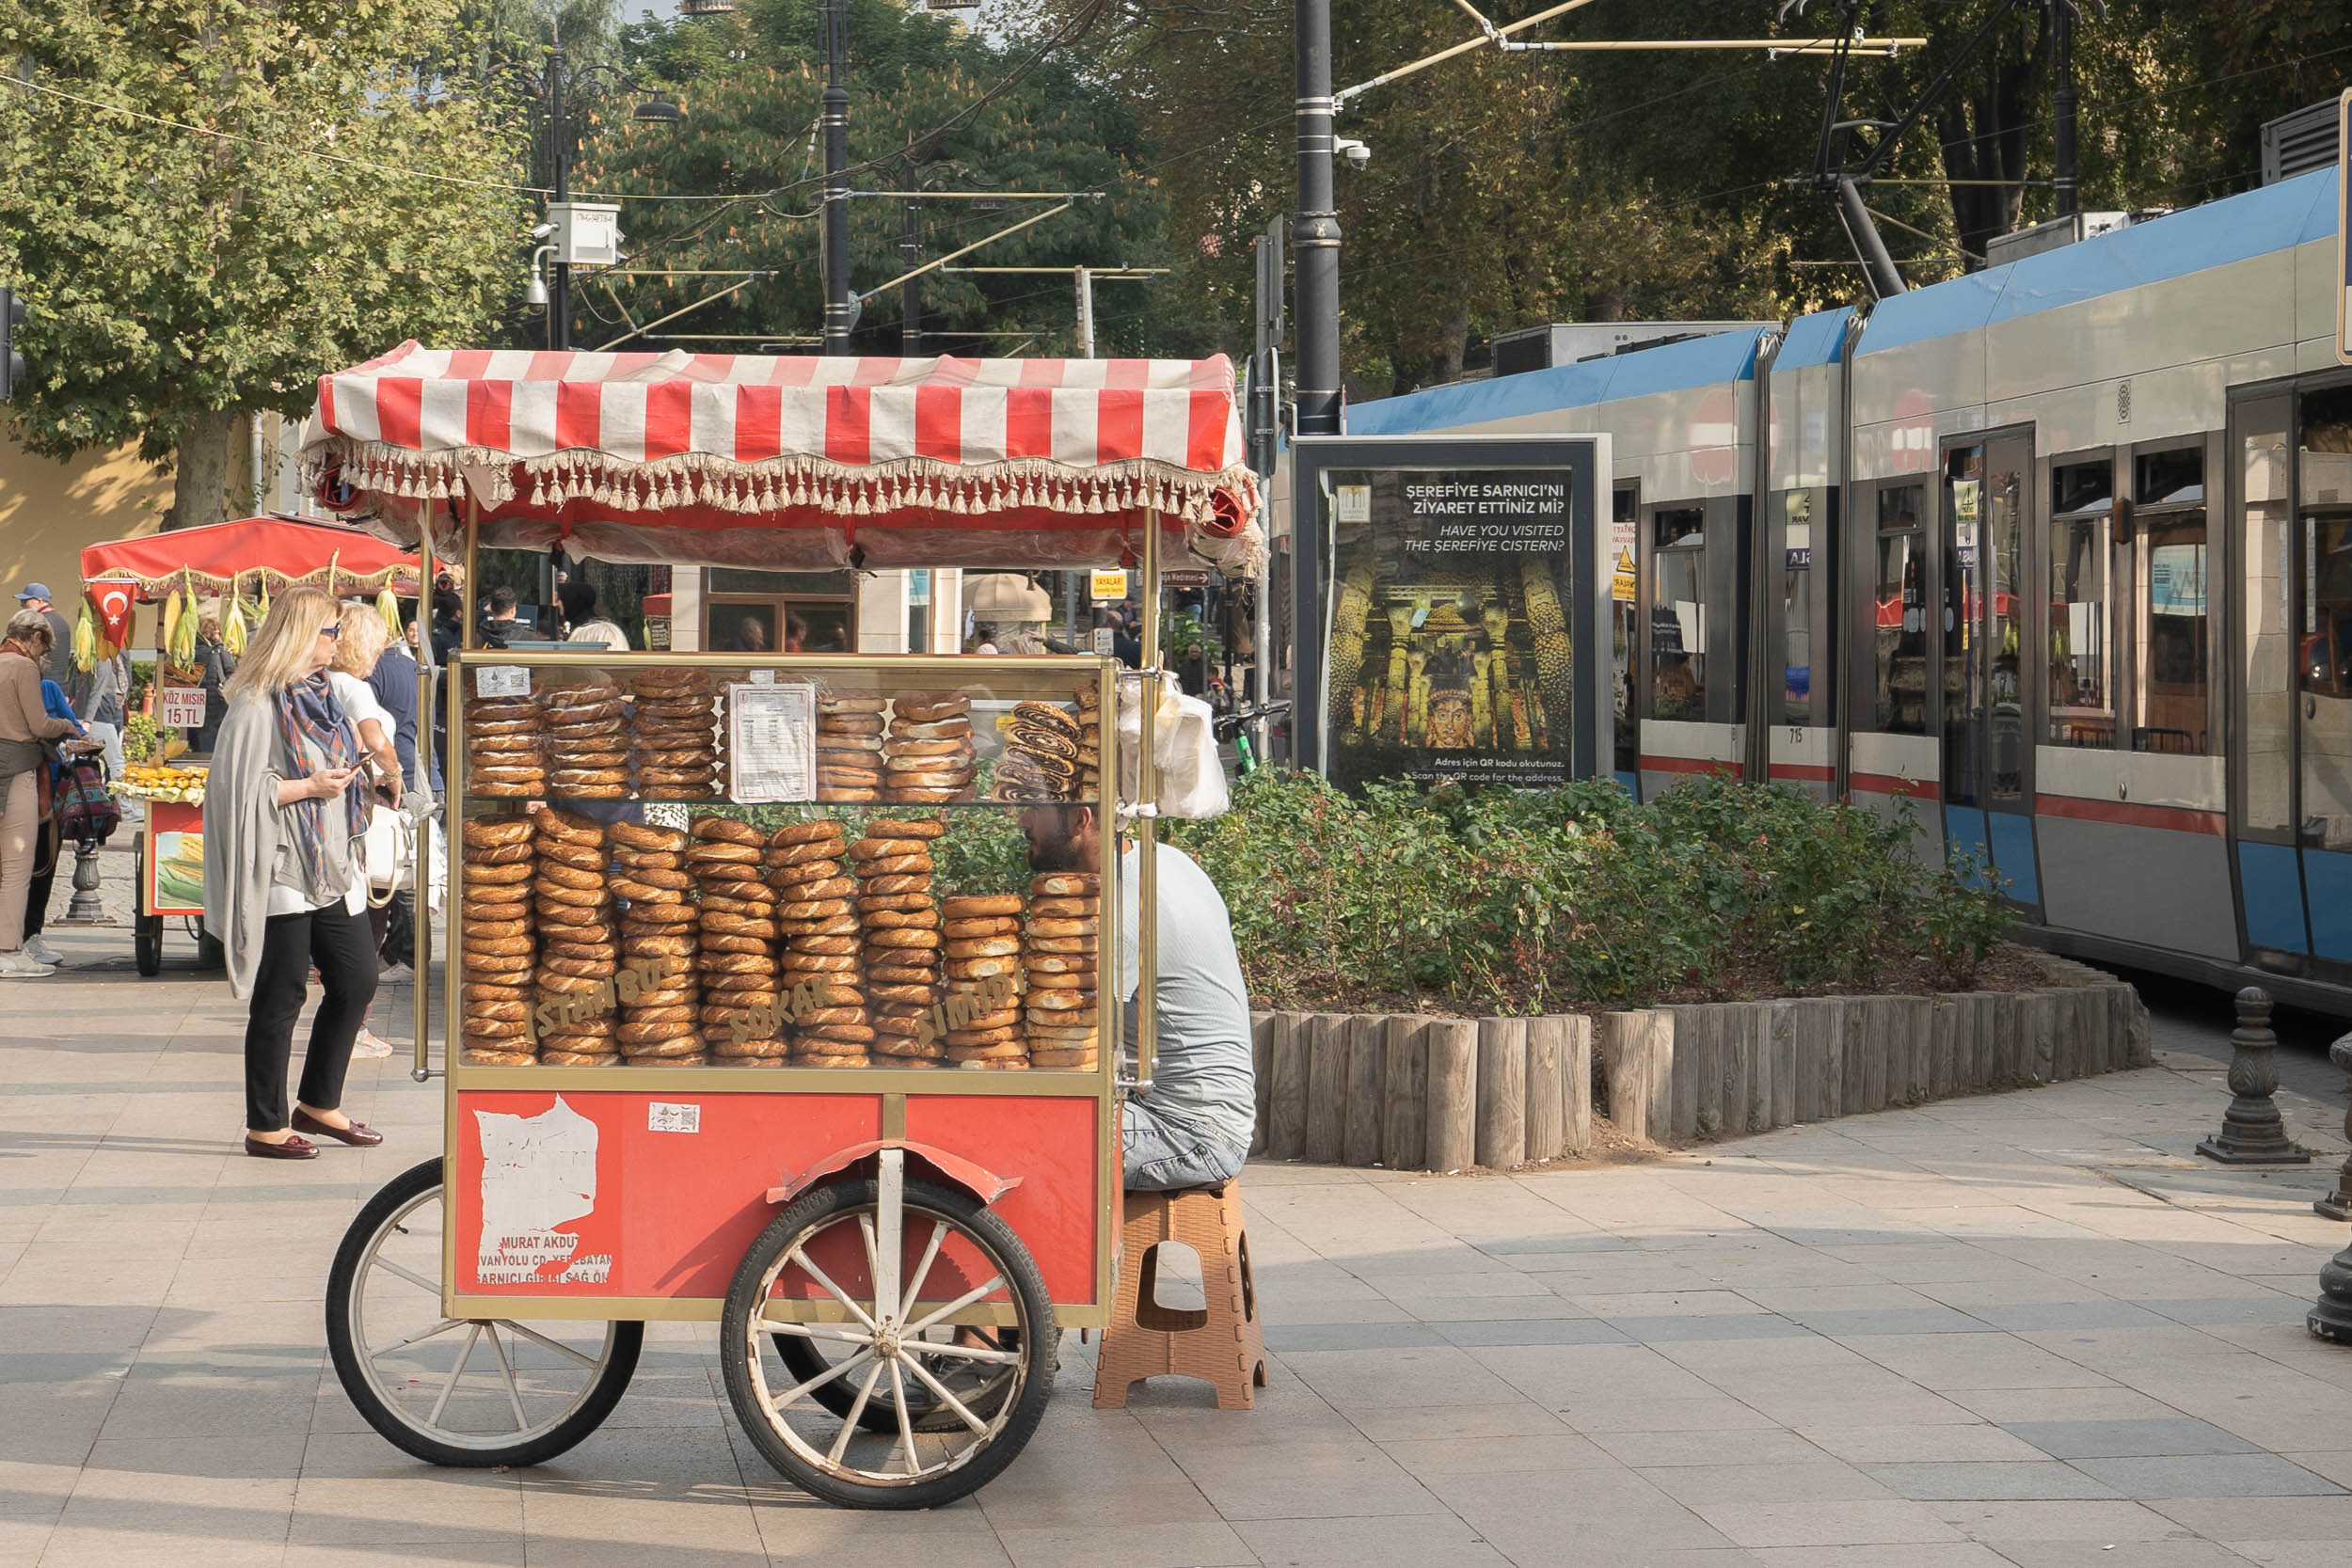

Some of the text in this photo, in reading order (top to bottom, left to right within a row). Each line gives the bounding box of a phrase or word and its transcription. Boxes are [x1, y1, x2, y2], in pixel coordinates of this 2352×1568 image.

[1406, 482, 1565, 499] ŞEREFİYE SARNICI'NI
[1413, 498, 1565, 515] ZİYARET ETTİNİZ Mİ?
[1439, 525, 1565, 536] HAVE YOU VISITED
[1405, 537, 1565, 554] THE ŞEREFİYE CISTERN?
[163, 690, 180, 705] KÖZ
[167, 707, 199, 724] 15 TL
[1788, 727, 1803, 744] 715
[1435, 757, 1461, 767] Adres
[1462, 757, 1478, 768] için
[1479, 758, 1494, 768] QR
[1495, 758, 1518, 768] kodu
[1411, 770, 1434, 780] Scan
[1453, 772, 1468, 781] QR
[1469, 772, 1490, 782] code
[1492, 772, 1505, 782] for
[1507, 773, 1523, 782] the
[1524, 773, 1565, 783] address.
[728, 971, 836, 1046] SOKAK
[501, 1236, 540, 1249] MURAT
